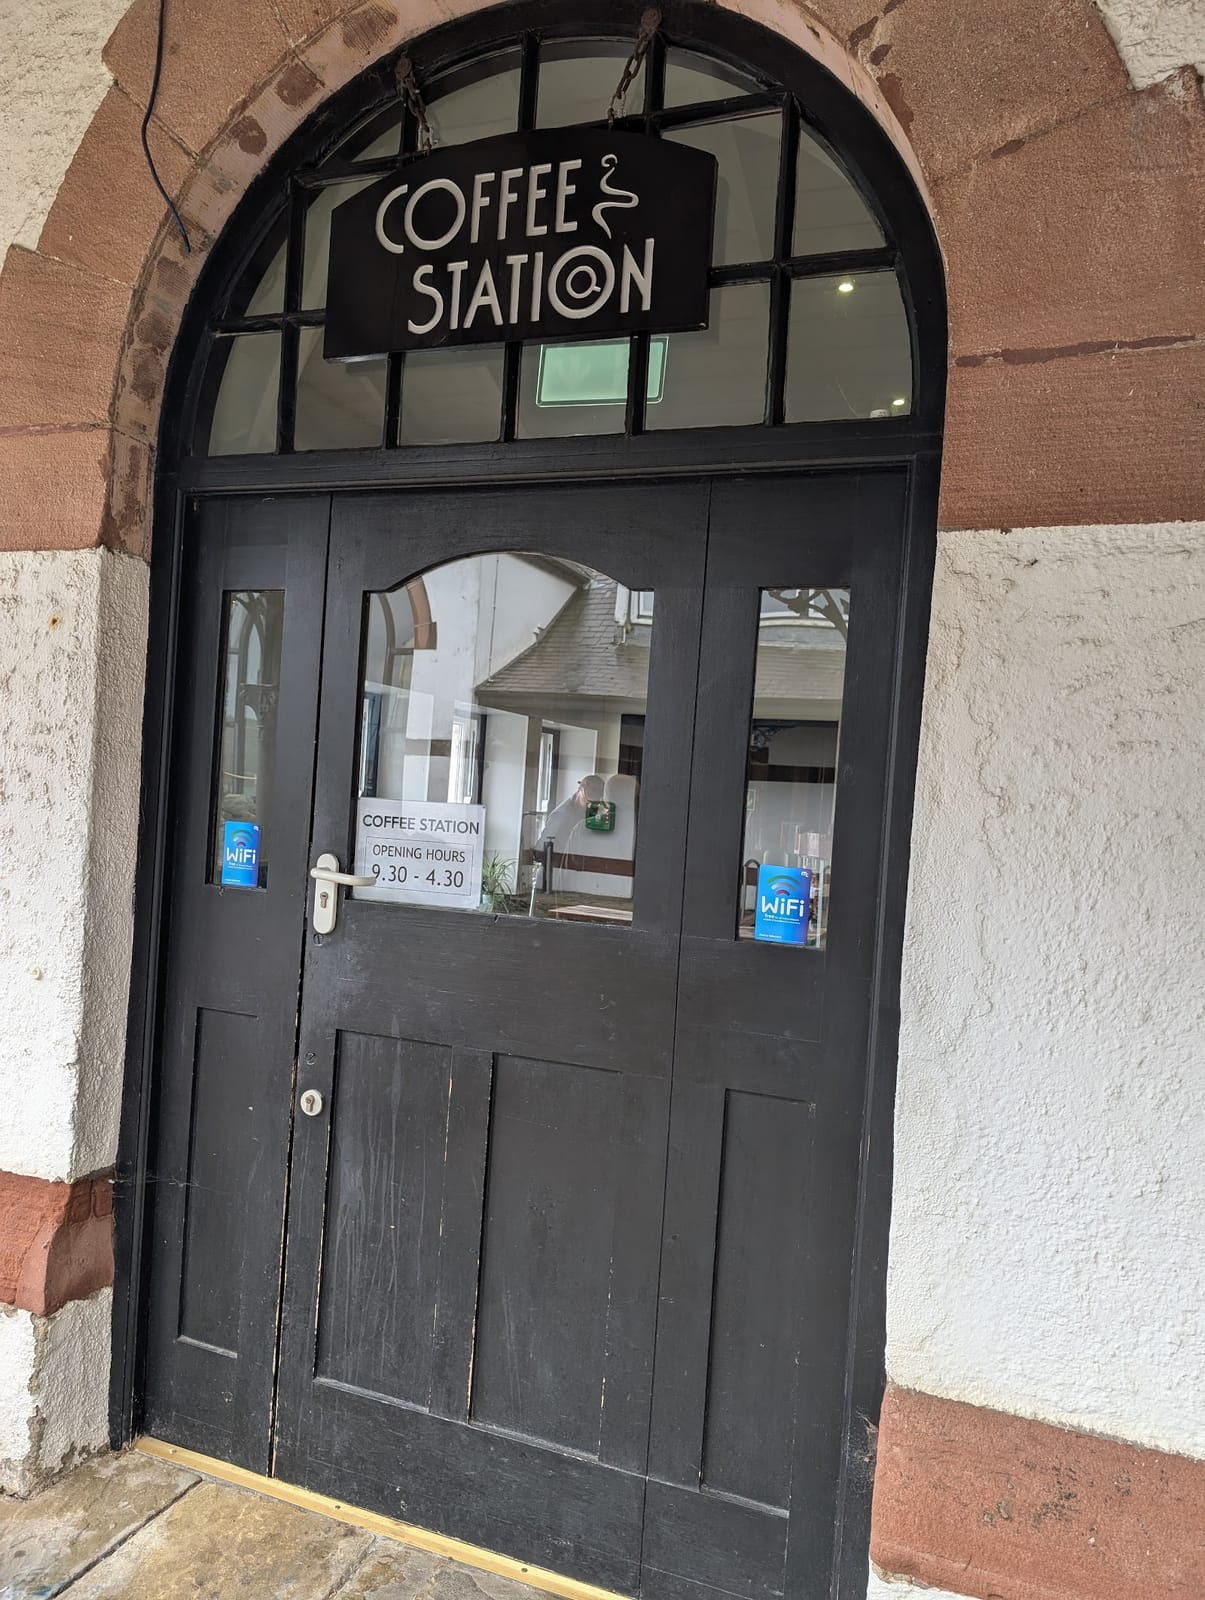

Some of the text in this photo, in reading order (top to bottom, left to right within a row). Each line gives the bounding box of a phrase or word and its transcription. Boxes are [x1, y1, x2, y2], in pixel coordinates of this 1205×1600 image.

[375, 159, 582, 254] COFFEE
[407, 238, 654, 335] STATION
[363, 815, 479, 835] COFFEE STATION
[226, 847, 257, 864] WiFi
[373, 845, 466, 863] OPENING HOURS
[372, 864, 407, 883] 9.30
[426, 869, 464, 888] 4.30
[761, 896, 805, 917] WiFi
